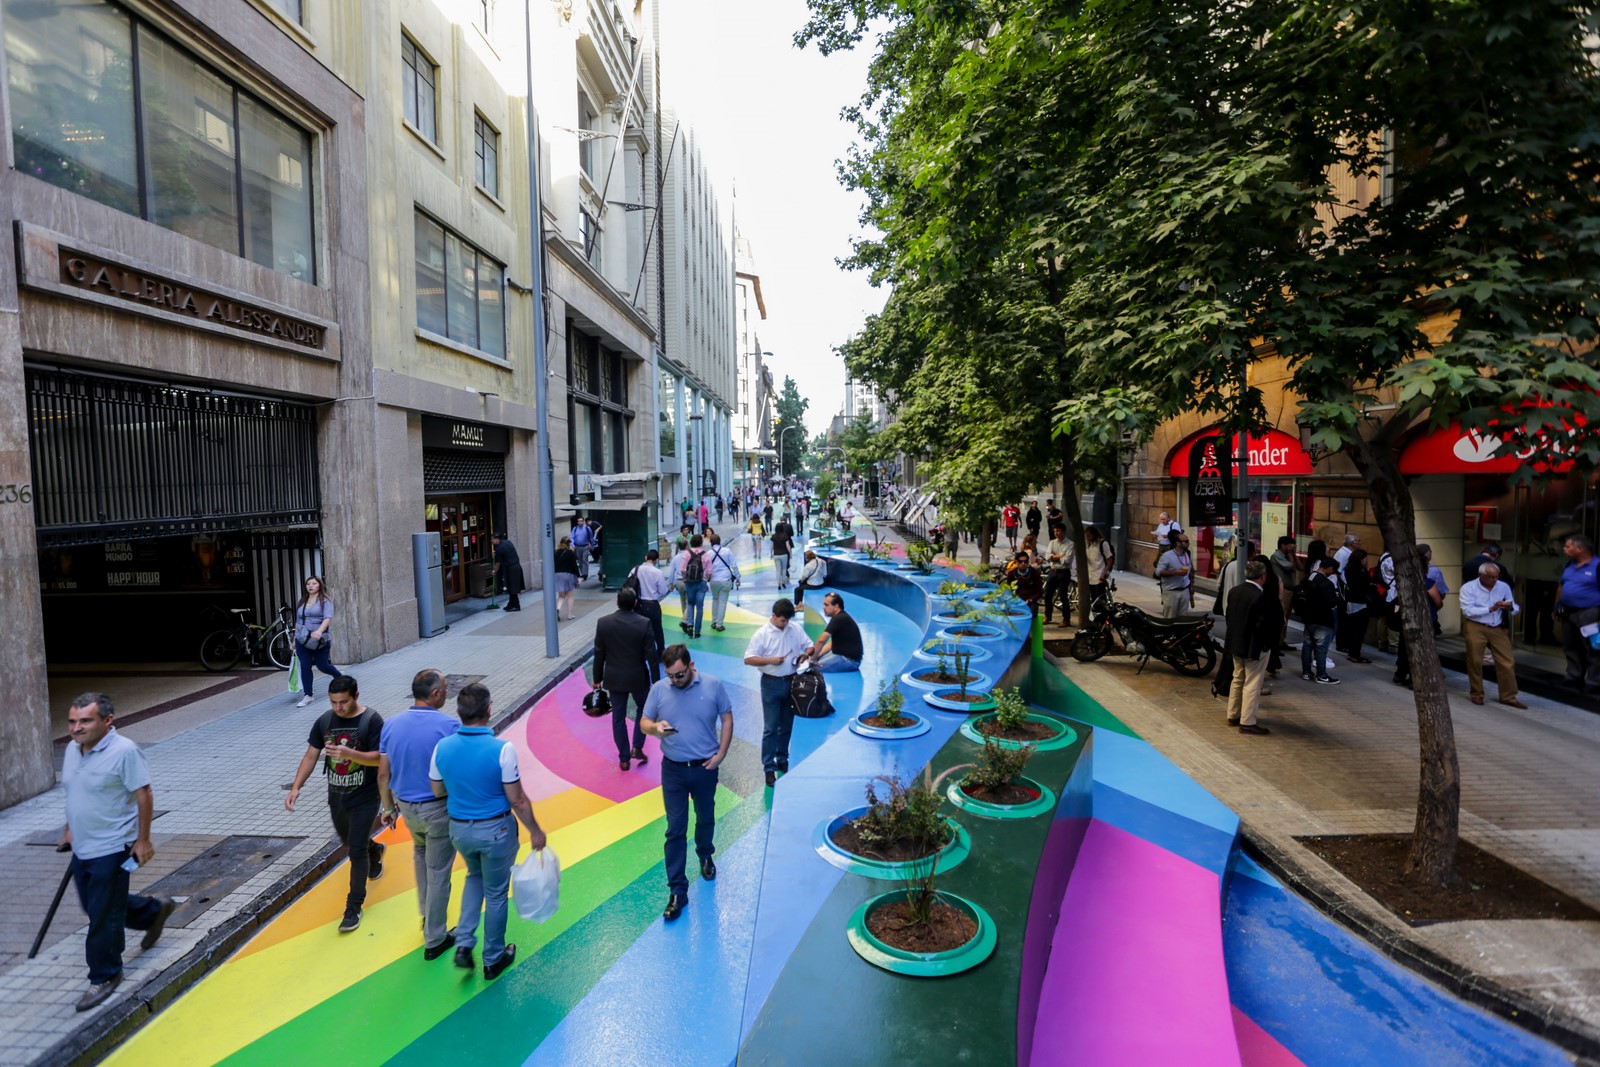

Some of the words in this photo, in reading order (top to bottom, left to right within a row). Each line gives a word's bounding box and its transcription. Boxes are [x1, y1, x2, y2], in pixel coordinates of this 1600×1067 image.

[66, 258, 201, 314] GALERIA
[207, 300, 320, 347] ALESSANDRI
[452, 424, 484, 441] MAMUT
[1231, 438, 1289, 467] tnder
[104, 542, 133, 552] BARRA
[105, 552, 133, 561] MUNDO
[136, 571, 161, 584] HOUR
